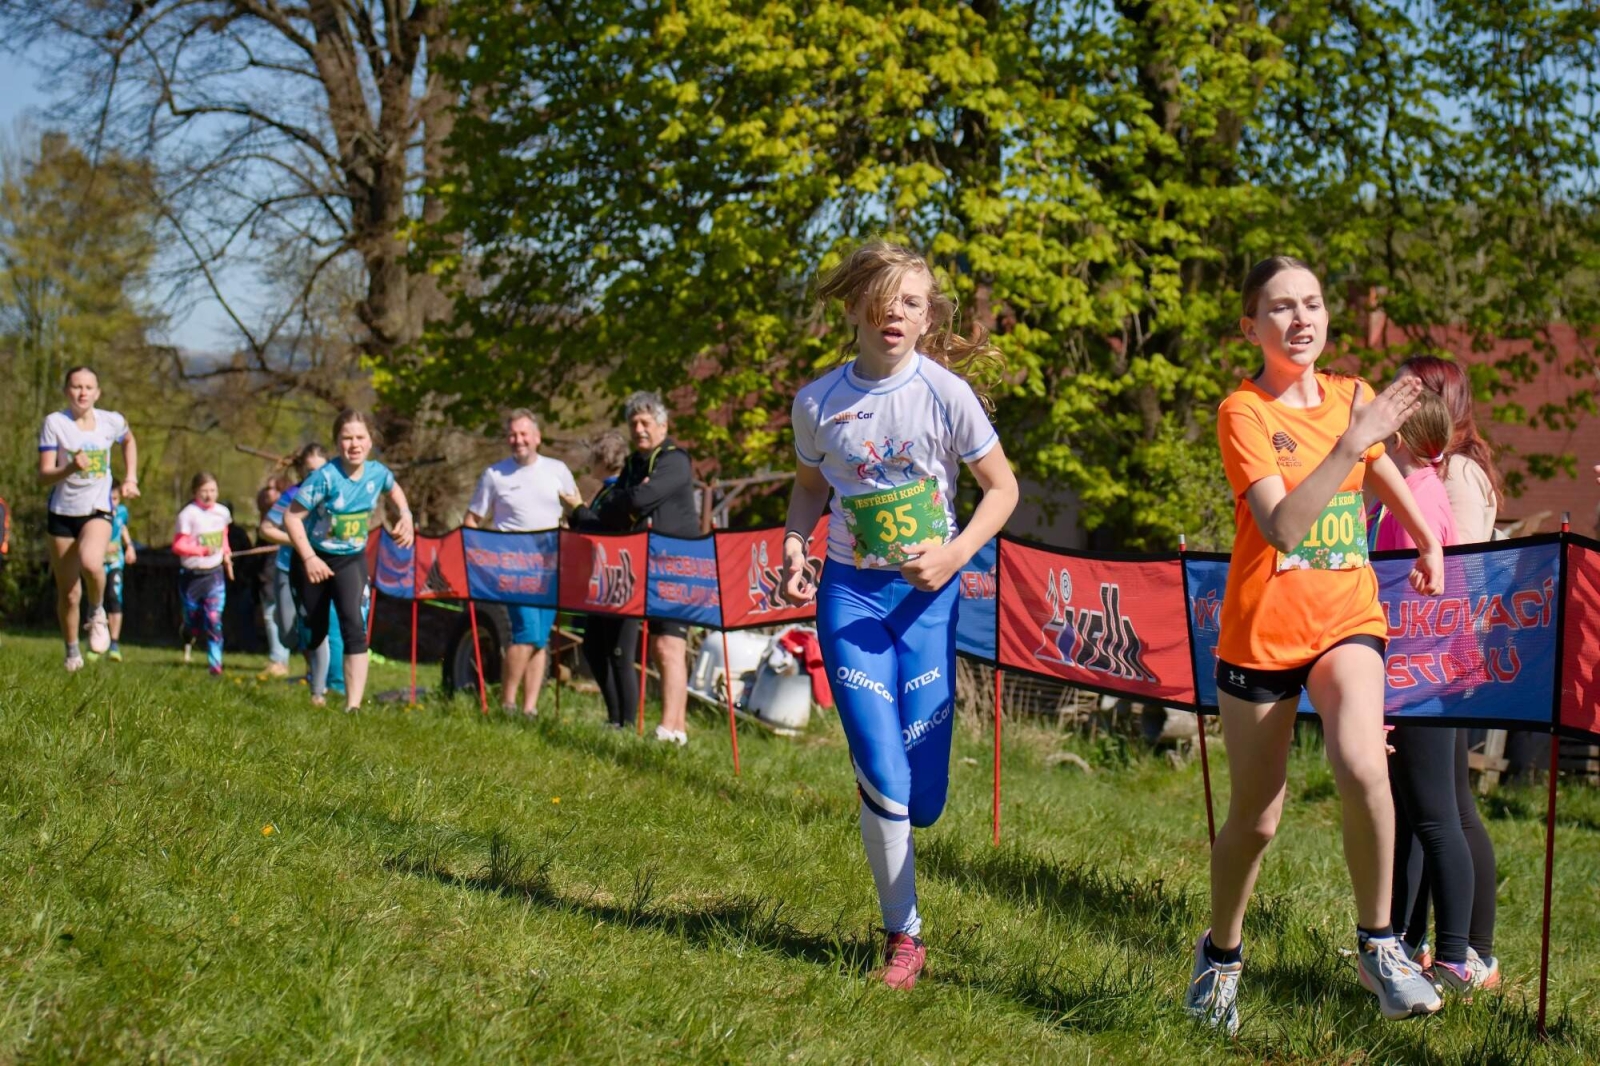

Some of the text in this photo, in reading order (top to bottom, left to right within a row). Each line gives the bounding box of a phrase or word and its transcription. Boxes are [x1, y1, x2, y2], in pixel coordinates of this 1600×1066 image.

[834, 410, 874, 422] OlfinCar
[854, 483, 926, 510] JESTŘEBÍ KROS
[343, 520, 361, 537] 19
[875, 503, 918, 543] 35
[1303, 511, 1354, 548] 100
[1383, 576, 1554, 639] UKOVACÍ
[837, 666, 894, 704] OlfinCar
[904, 666, 941, 695] ATEX
[902, 703, 952, 745] OlfinCar
